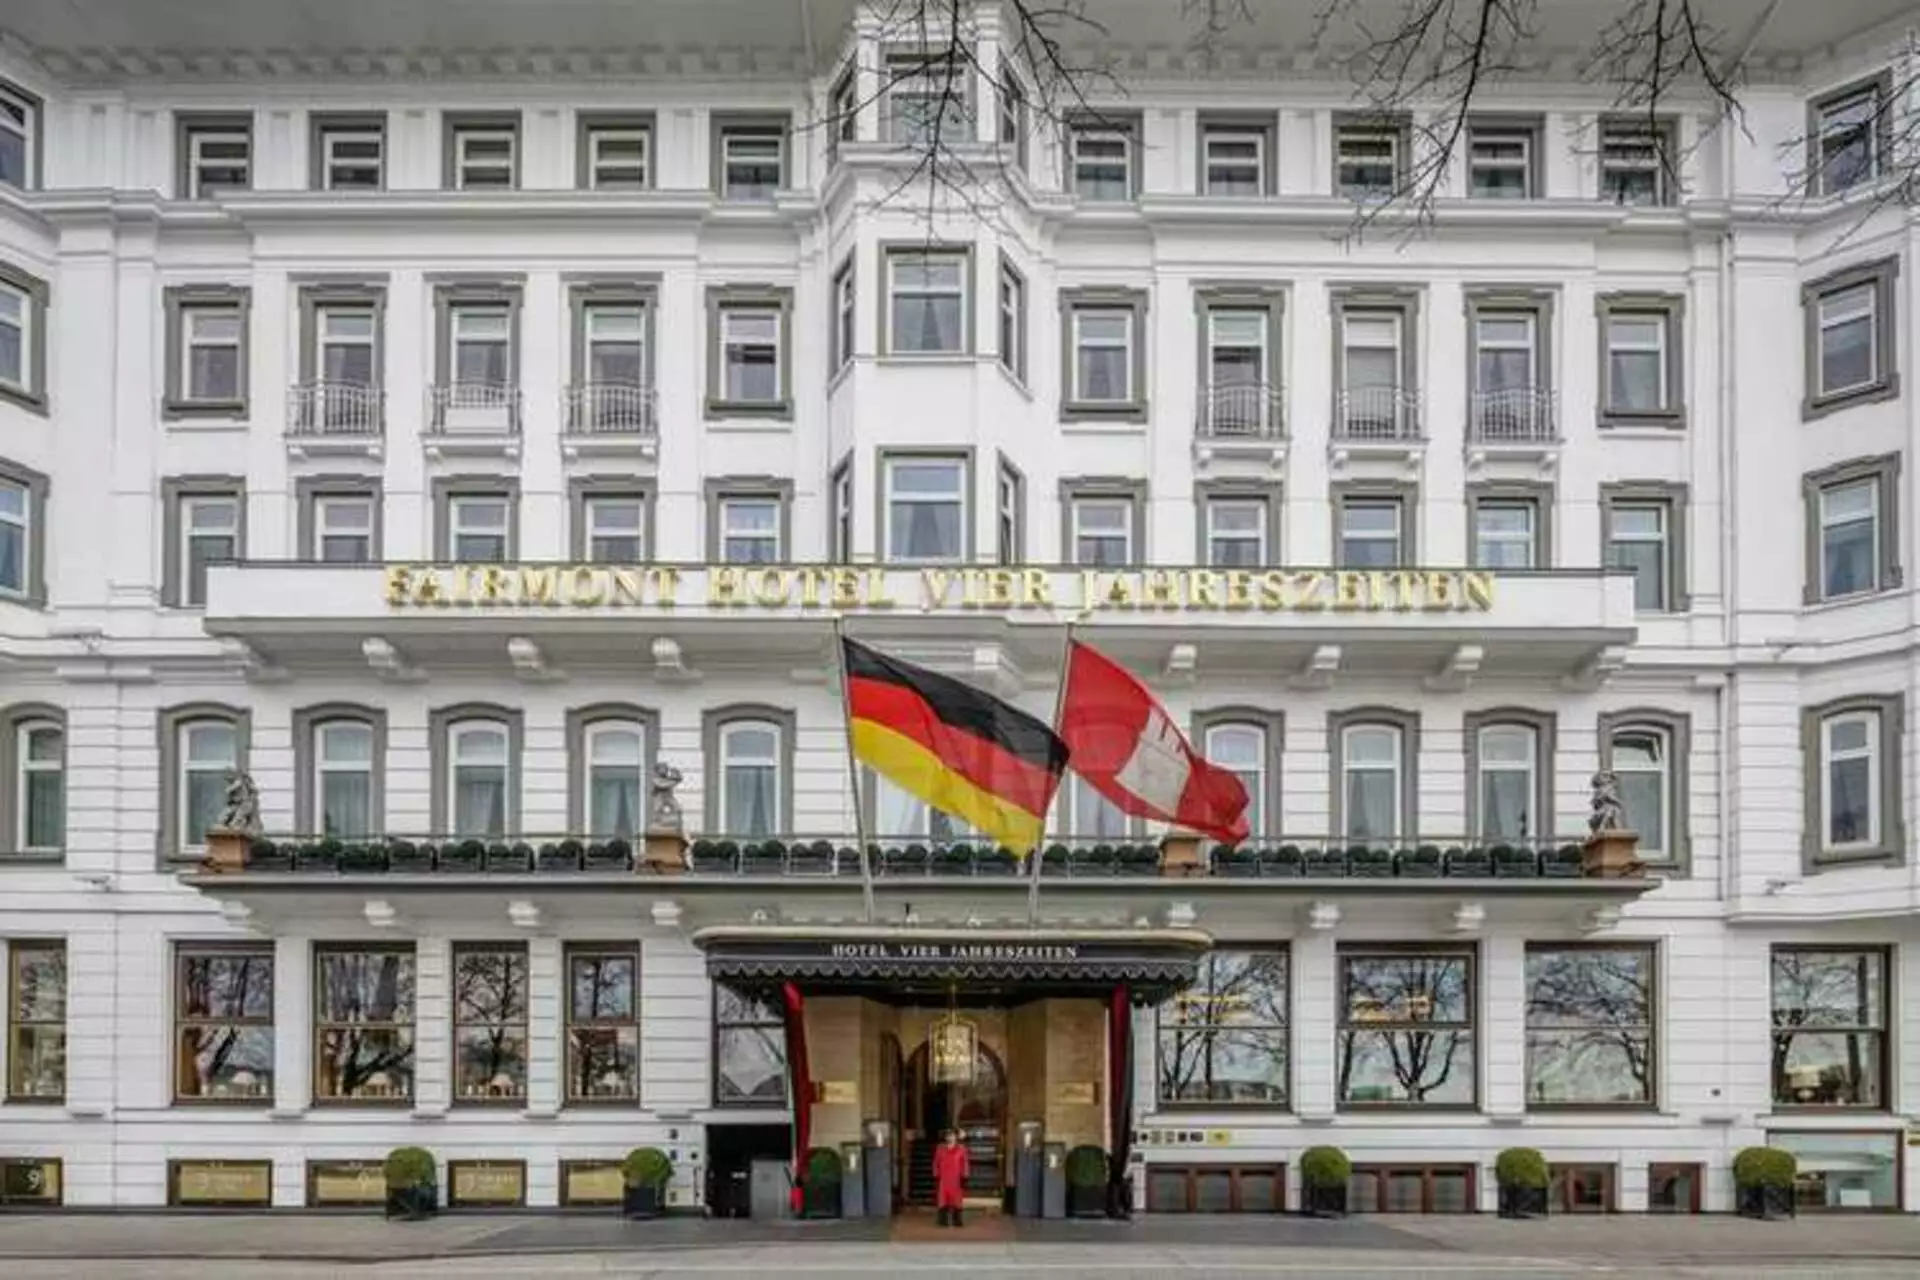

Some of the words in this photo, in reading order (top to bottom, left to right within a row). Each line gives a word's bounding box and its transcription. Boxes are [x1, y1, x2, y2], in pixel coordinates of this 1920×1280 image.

[384, 565, 680, 609] FAIRMONT
[706, 566, 895, 609] HOTEL
[920, 567, 1052, 611] VIER
[1078, 567, 1495, 617] JAHRESZEITEN
[831, 943, 888, 958] HOTEL
[900, 944, 942, 958] VIER
[951, 943, 1078, 959] JAHRESZEITEN
